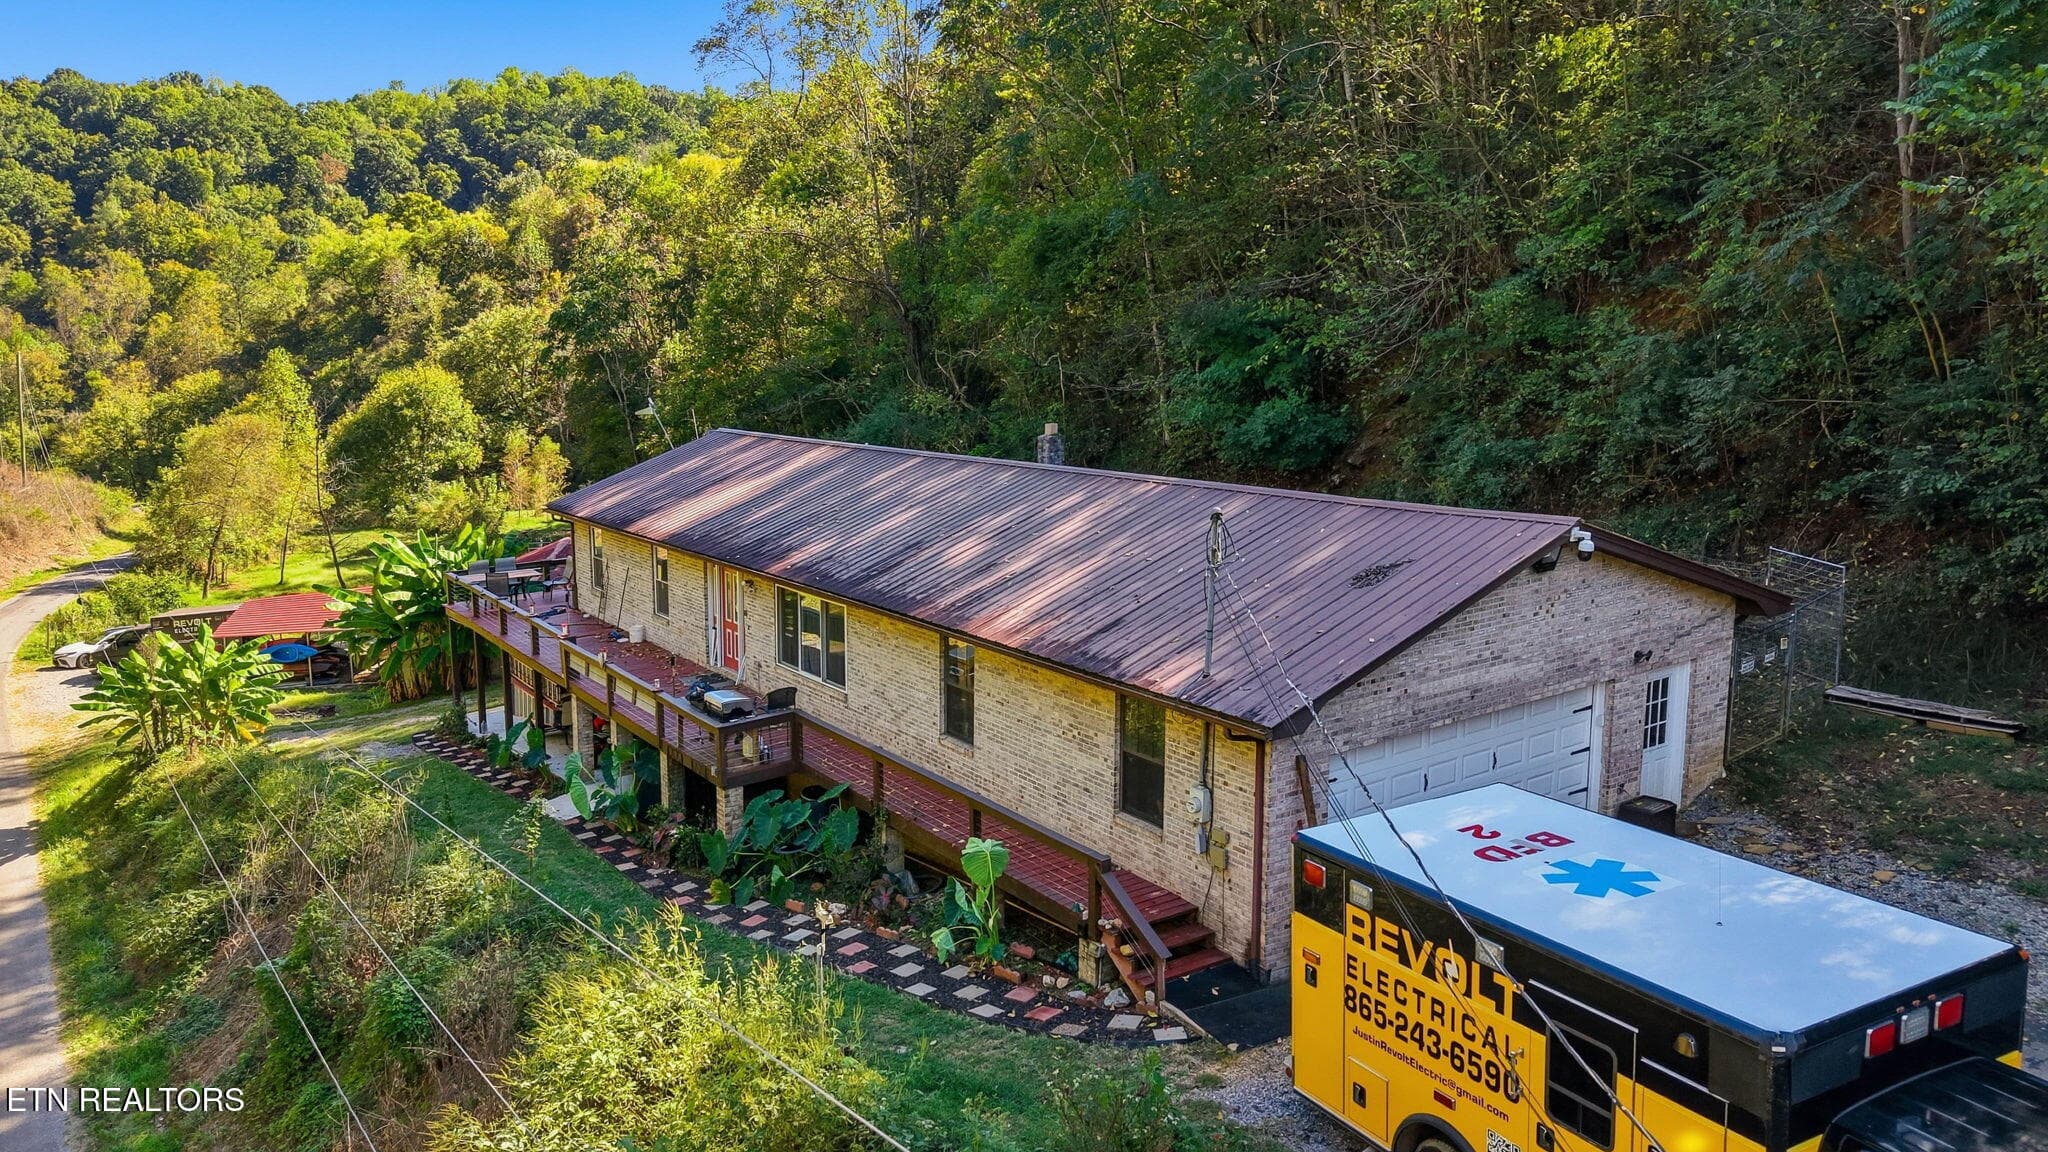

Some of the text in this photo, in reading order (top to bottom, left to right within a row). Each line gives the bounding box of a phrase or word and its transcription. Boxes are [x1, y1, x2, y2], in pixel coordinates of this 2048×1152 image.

[173, 617, 212, 628] REVOLT
[1456, 824, 1502, 840] 2
[1345, 903, 1525, 1020] REVOLT
[1346, 953, 1518, 1065] ELECTRICAL
[1344, 983, 1522, 1104] 865-243-6590
[1352, 1026, 1510, 1123] JustinRevoltElectric@gmail.com
